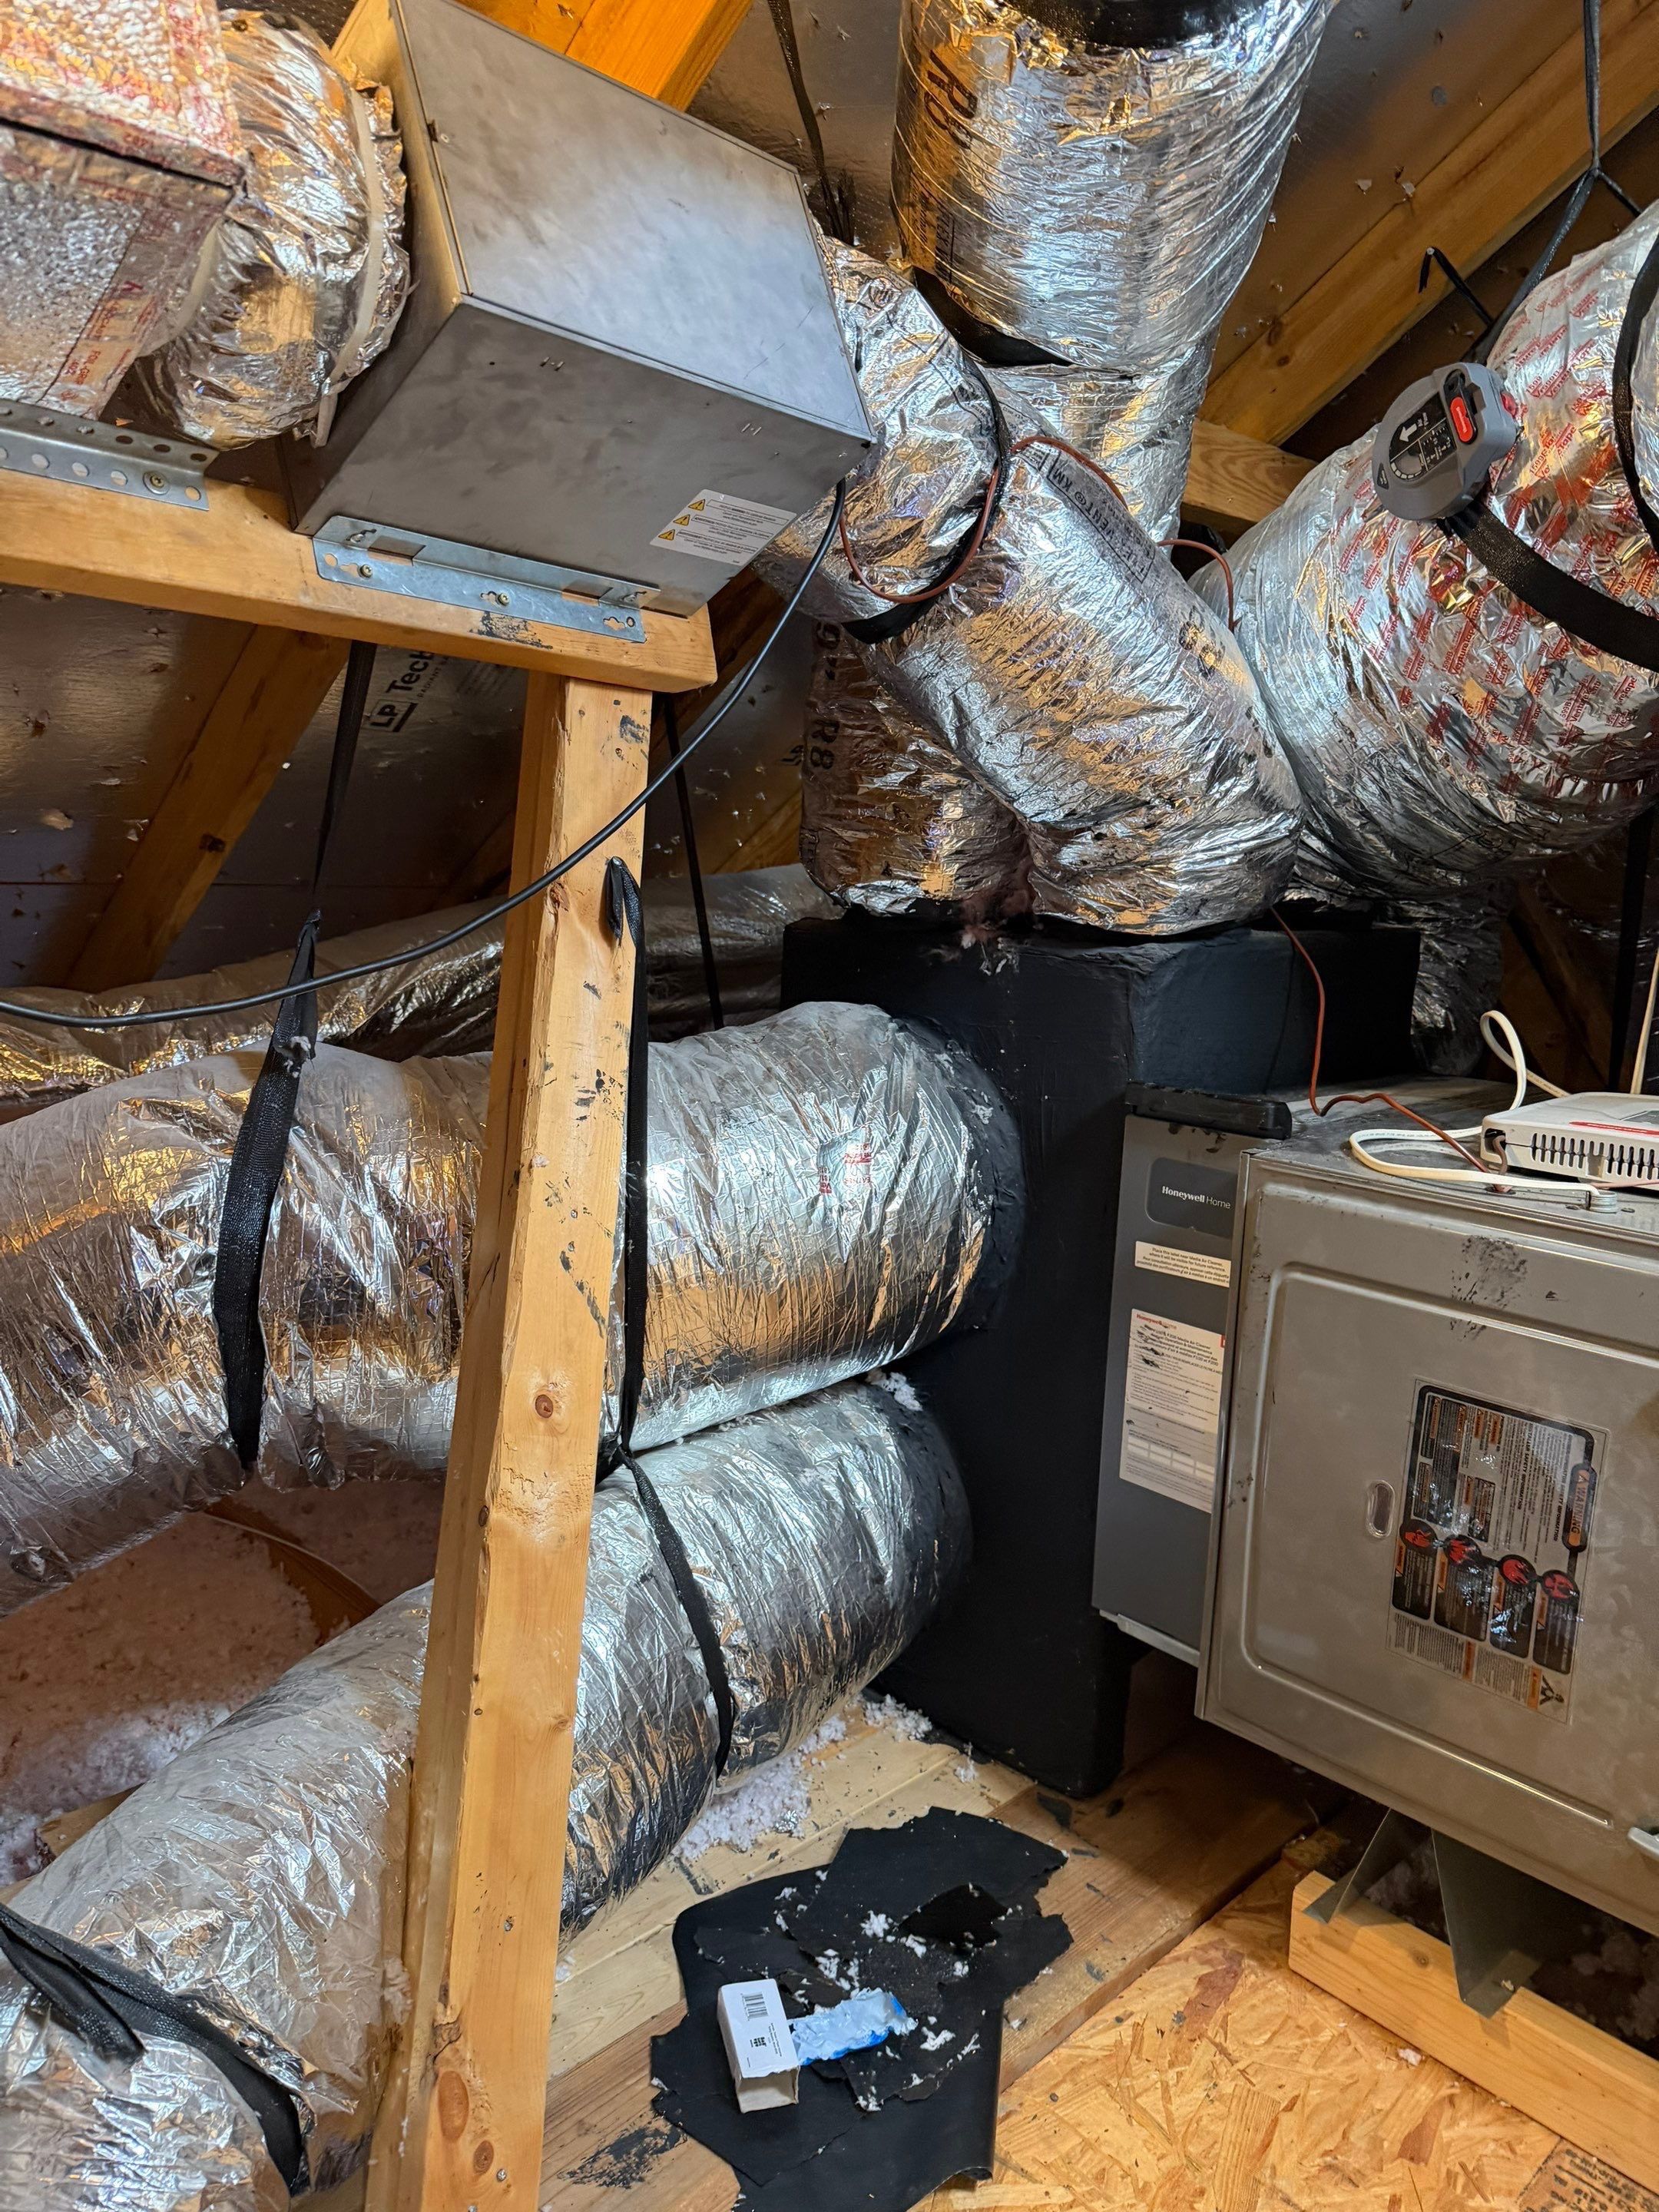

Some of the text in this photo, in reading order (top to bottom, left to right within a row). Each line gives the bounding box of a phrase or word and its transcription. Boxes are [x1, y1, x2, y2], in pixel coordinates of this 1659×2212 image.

[370, 704, 399, 728] LP
[1161, 1185, 1231, 1209] Honeywell Home
[1571, 1486, 1588, 1535] WARNING
